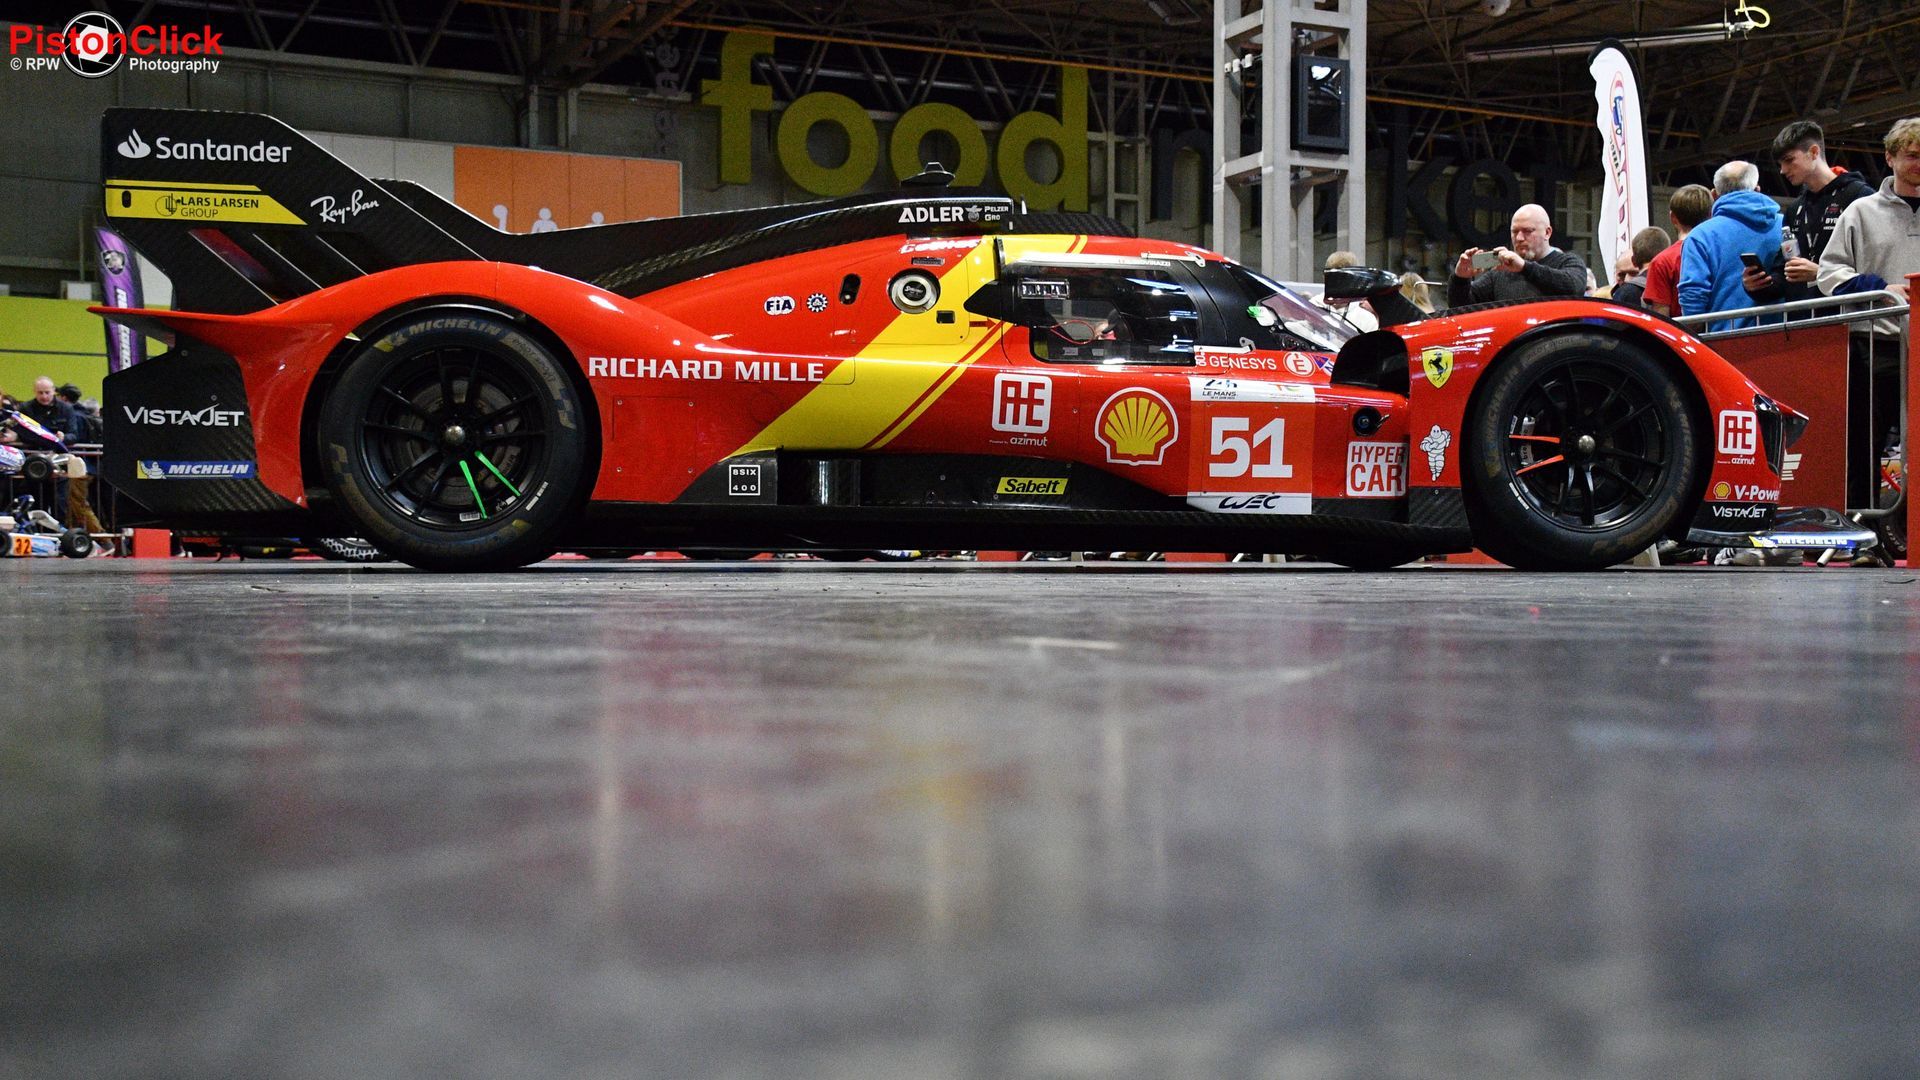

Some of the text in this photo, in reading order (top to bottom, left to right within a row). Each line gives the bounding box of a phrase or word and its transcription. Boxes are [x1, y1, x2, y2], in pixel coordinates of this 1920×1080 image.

[701, 27, 1088, 213] food
[156, 137, 292, 163] Santander
[181, 197, 259, 208] LARS LARSEN
[181, 208, 218, 218] GROUP
[898, 206, 964, 223] ADLER
[408, 317, 503, 337] MICHELIN
[589, 357, 824, 382] RICHARD MILLE
[1209, 355, 1277, 370] GENESYS
[1010, 433, 1048, 447] azimut
[1209, 417, 1293, 478] 51
[1351, 446, 1405, 463] HYPER
[1731, 455, 1755, 465] azimut
[168, 464, 249, 475] MICHELIN
[1350, 464, 1402, 492] CAR
[1004, 479, 1061, 494] Sabelt
[1218, 494, 1281, 509] WEC
[15, 538, 32, 555] 32
[1777, 535, 1849, 545] MICHELIN
